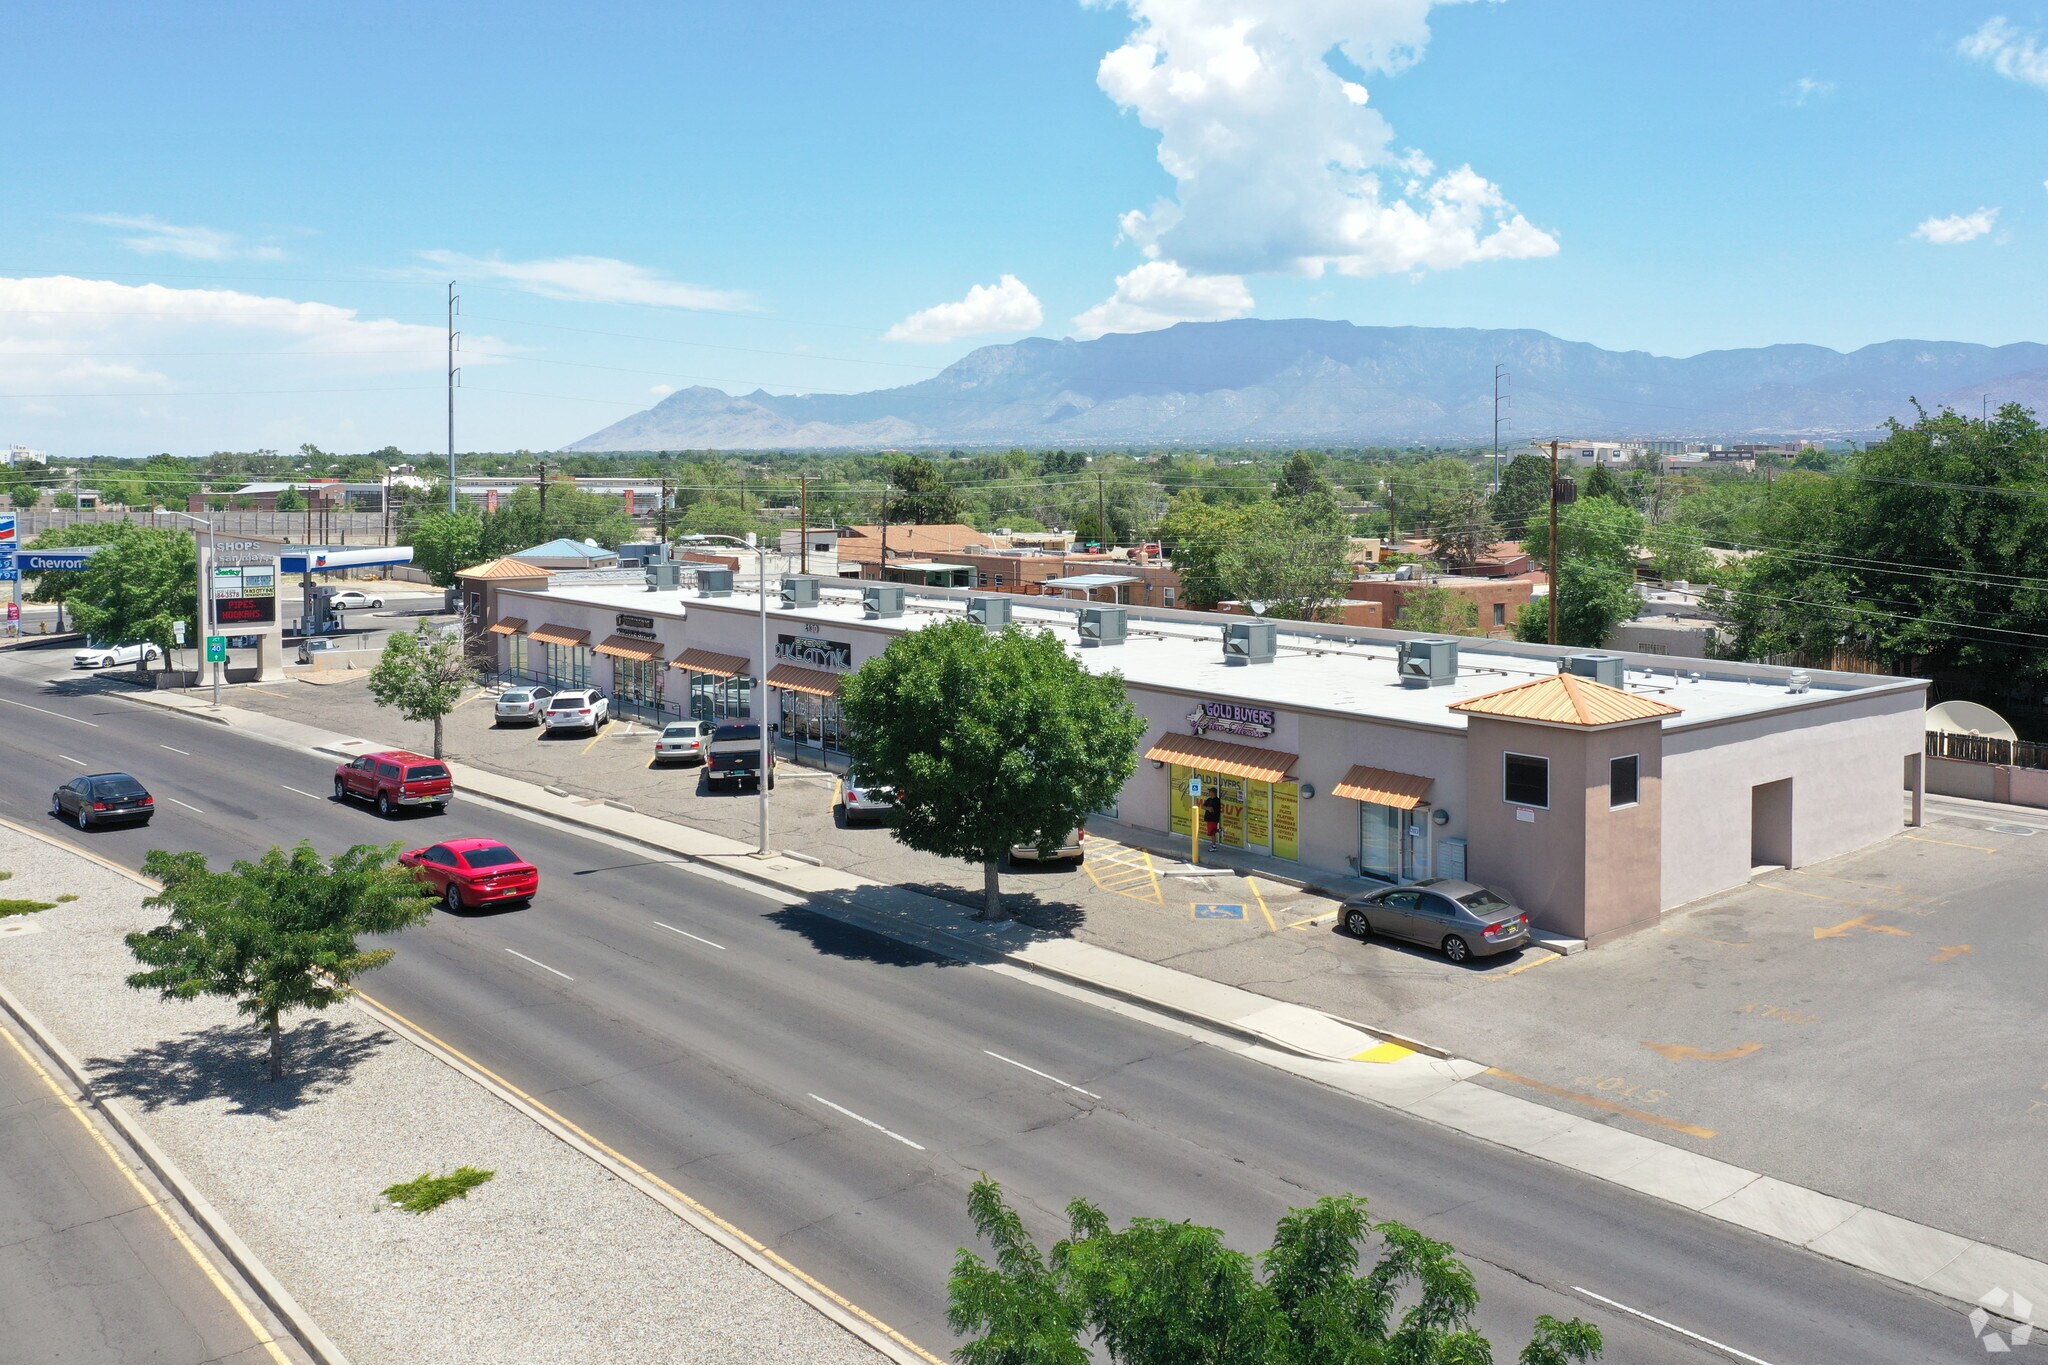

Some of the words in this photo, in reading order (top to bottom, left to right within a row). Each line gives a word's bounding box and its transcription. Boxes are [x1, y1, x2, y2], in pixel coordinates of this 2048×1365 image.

[216, 541, 261, 551] SHOPS
[30, 557, 82, 569] Chevron
[775, 642, 804, 662] DUKE
[803, 648, 830, 667] CITY
[1207, 703, 1232, 719] GOLD
[1234, 707, 1272, 725] BUYERS
[1219, 803, 1243, 817] BUY
